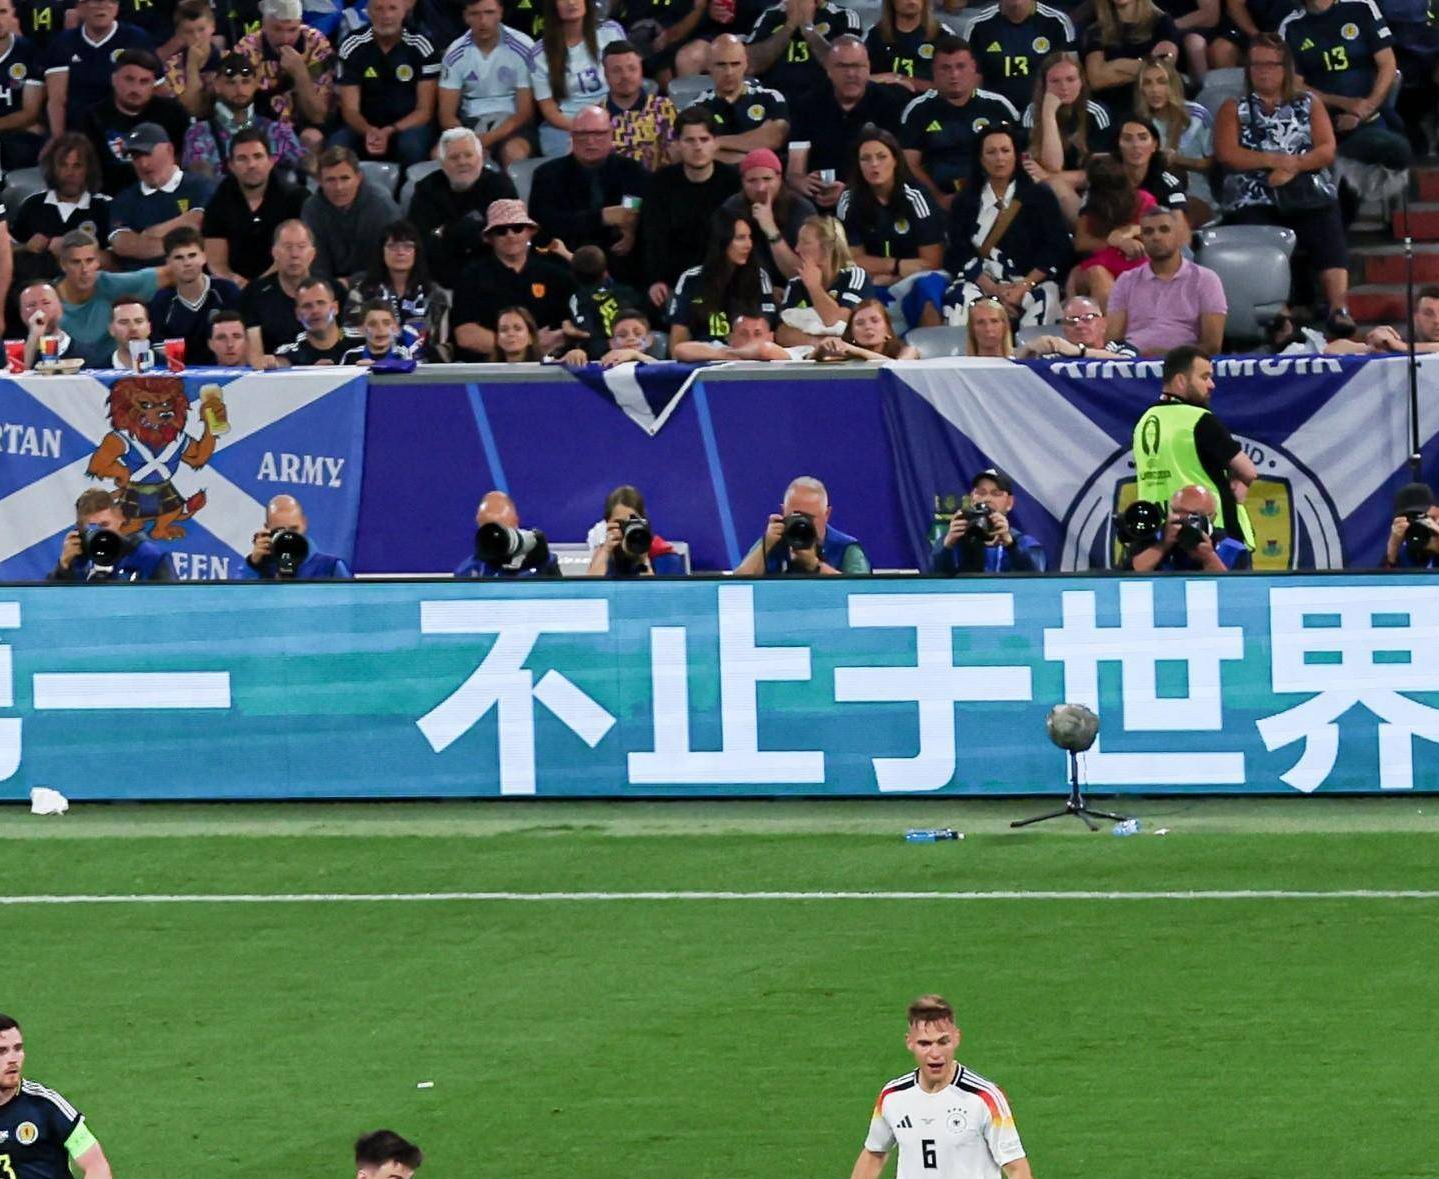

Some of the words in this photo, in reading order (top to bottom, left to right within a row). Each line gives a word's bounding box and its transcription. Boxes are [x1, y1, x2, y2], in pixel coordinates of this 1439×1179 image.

[1323, 46, 1350, 72] 13
[577, 67, 602, 94] 13
[257, 451, 345, 488] ARMY
[922, 1139, 937, 1169] 6
